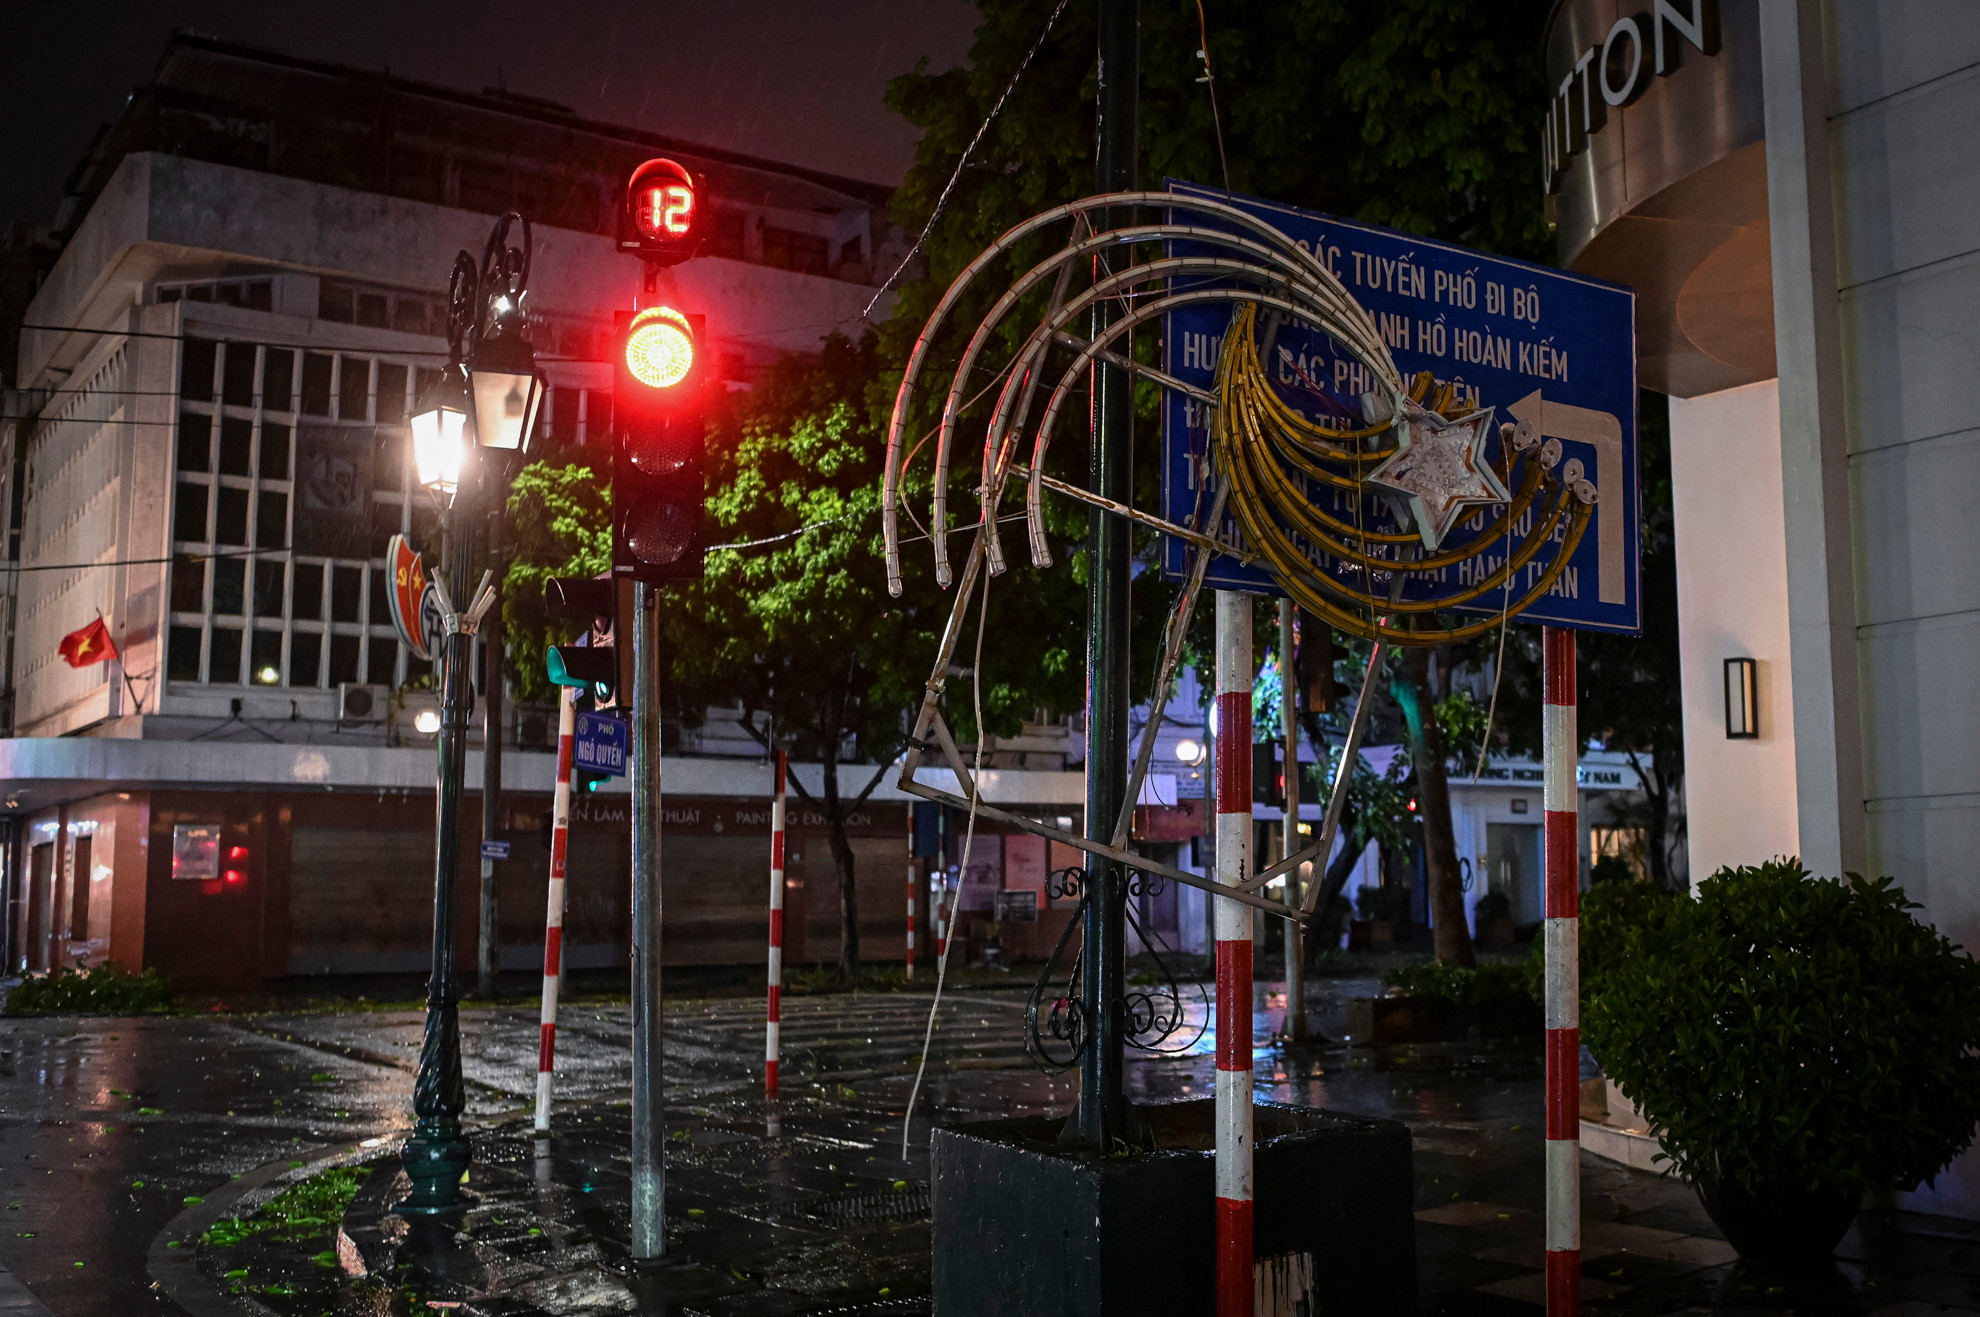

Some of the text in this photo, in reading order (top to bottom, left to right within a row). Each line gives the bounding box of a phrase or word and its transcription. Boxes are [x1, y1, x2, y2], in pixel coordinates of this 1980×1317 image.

[652, 187, 691, 233] 12
[1351, 251, 1426, 300] TUYẾN
[1434, 266, 1479, 310] PHỐ
[1484, 281, 1506, 317] ĐI
[1513, 284, 1541, 330] BỘ
[1418, 313, 1447, 357] HỒ
[1454, 324, 1511, 371] HOÀN
[1518, 336, 1568, 383] KIẾM
[736, 810, 798, 826] PAINTG
